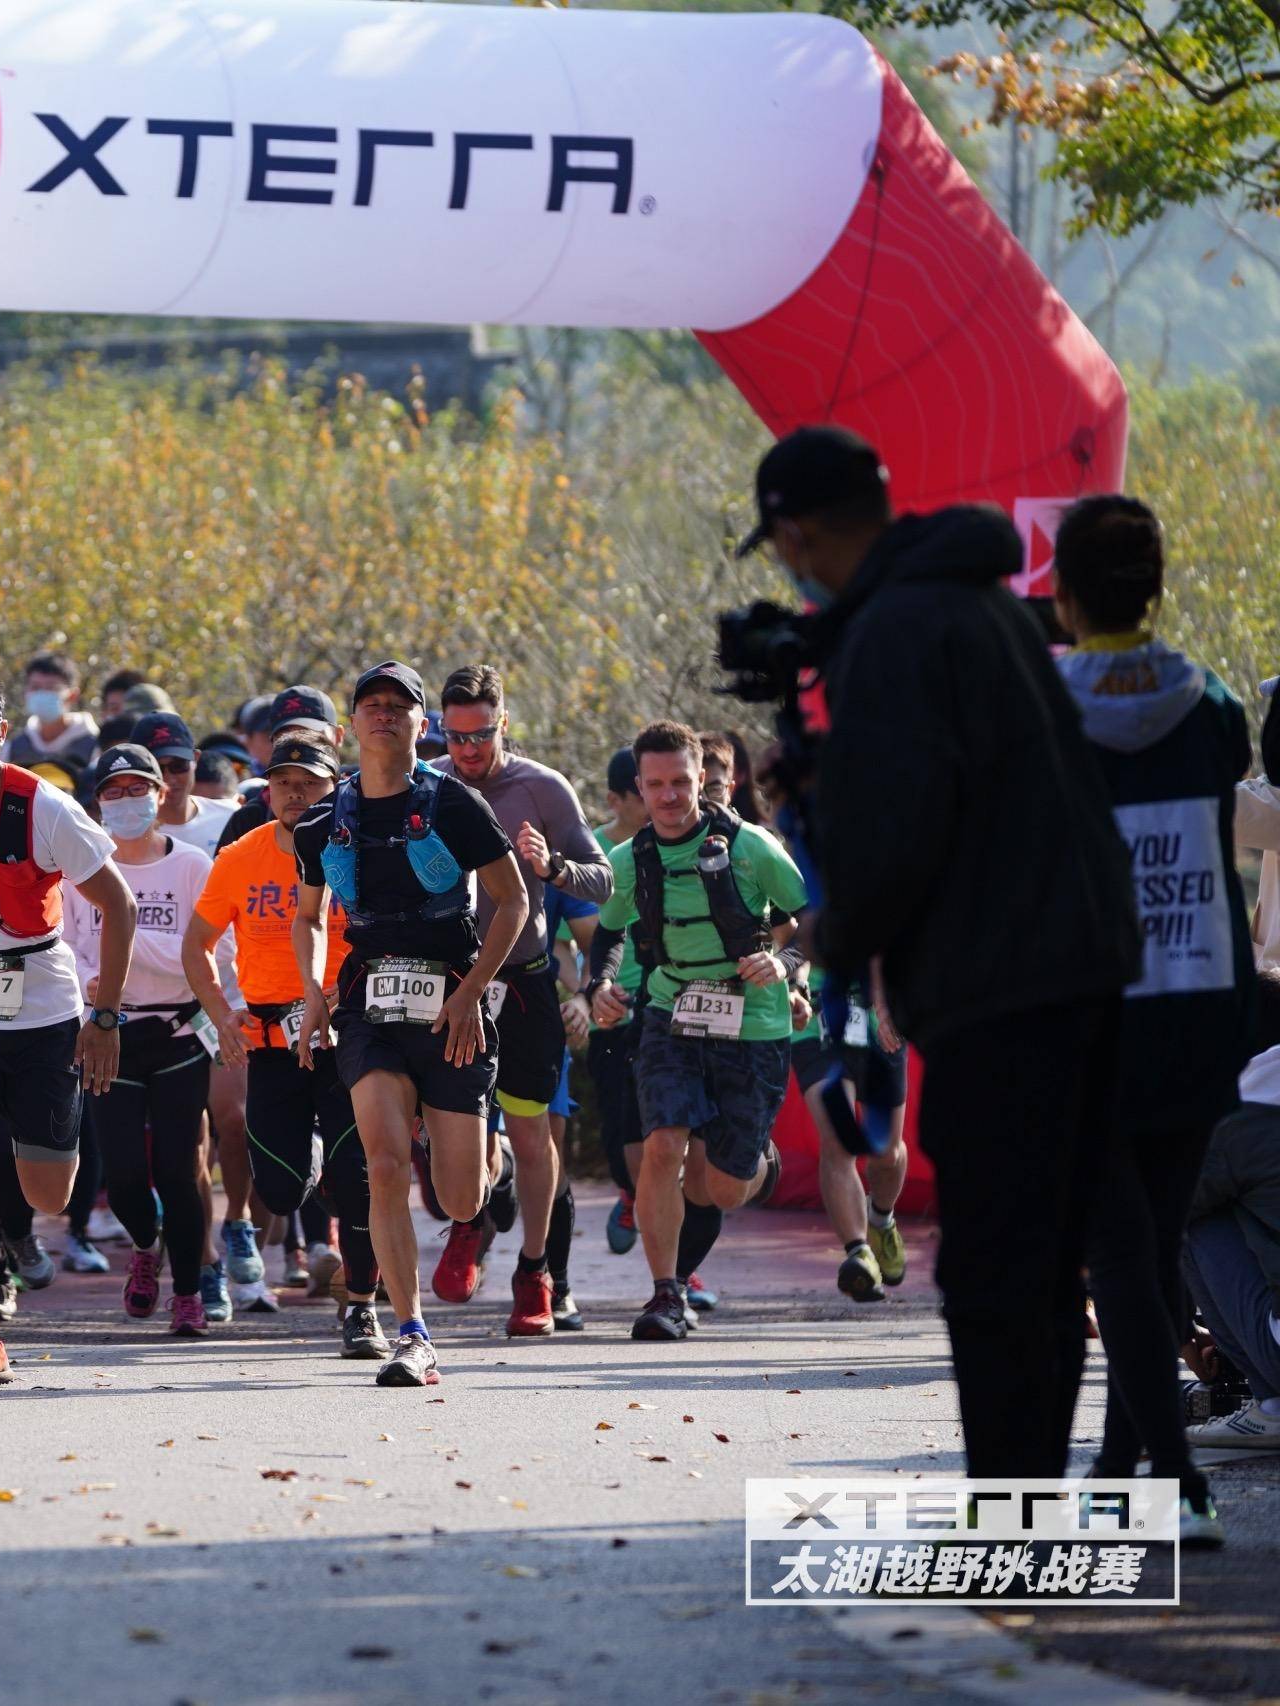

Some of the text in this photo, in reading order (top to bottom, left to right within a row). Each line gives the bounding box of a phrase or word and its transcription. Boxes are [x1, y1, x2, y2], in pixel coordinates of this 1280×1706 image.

[25, 112, 634, 215] XTERRA
[378, 978, 435, 997] CM 100
[703, 999, 733, 1015] 231
